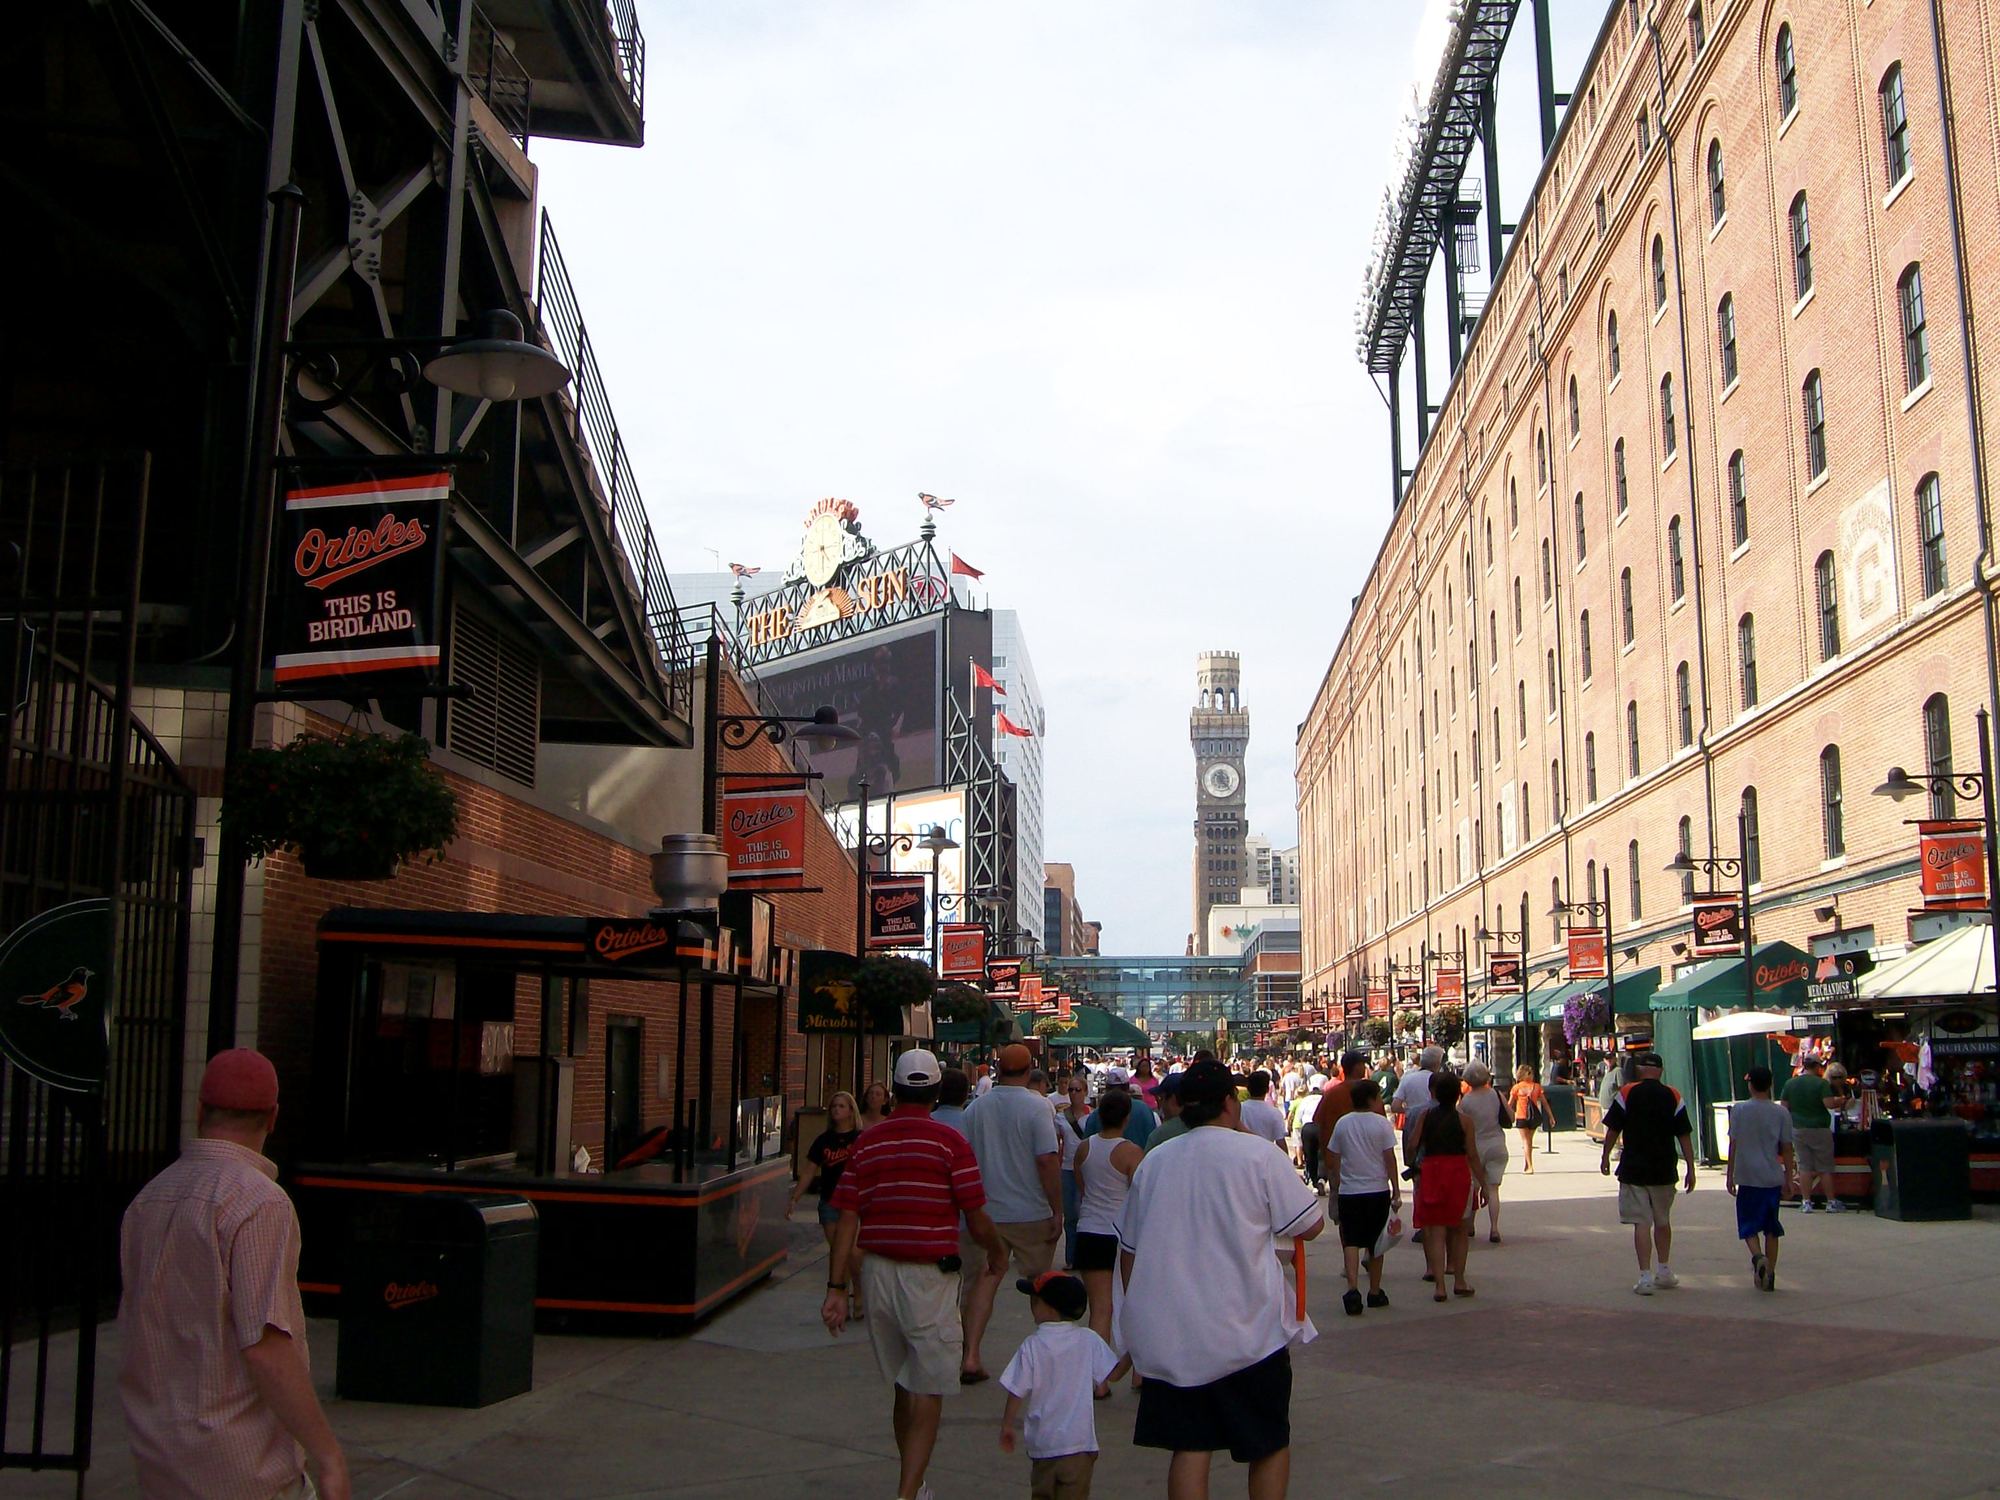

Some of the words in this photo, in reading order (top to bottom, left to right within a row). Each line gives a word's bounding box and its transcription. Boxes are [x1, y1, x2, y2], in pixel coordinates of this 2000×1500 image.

[294, 513, 427, 590] Orioles
[325, 595, 371, 617] THIS
[377, 590, 396, 610] IS
[748, 605, 792, 647] THE
[857, 566, 908, 613] SUN
[309, 608, 416, 642] BIRDLAND.
[730, 803, 796, 838] Orioles
[746, 841, 770, 853] THIS
[772, 840, 782, 849] IS
[1928, 842, 1976, 871] Orioles
[1941, 872, 1959, 881] THIS
[1961, 870, 1969, 879] IS
[875, 891, 920, 916] Orioles
[886, 917, 902, 925] THIS
[1697, 908, 1735, 930] Orioles
[594, 922, 669, 960] Orioles
[1807, 981, 1851, 998] MERCHANDISE
[1379, 1076, 1388, 1089] 4
[383, 1280, 442, 1310] Orioles
